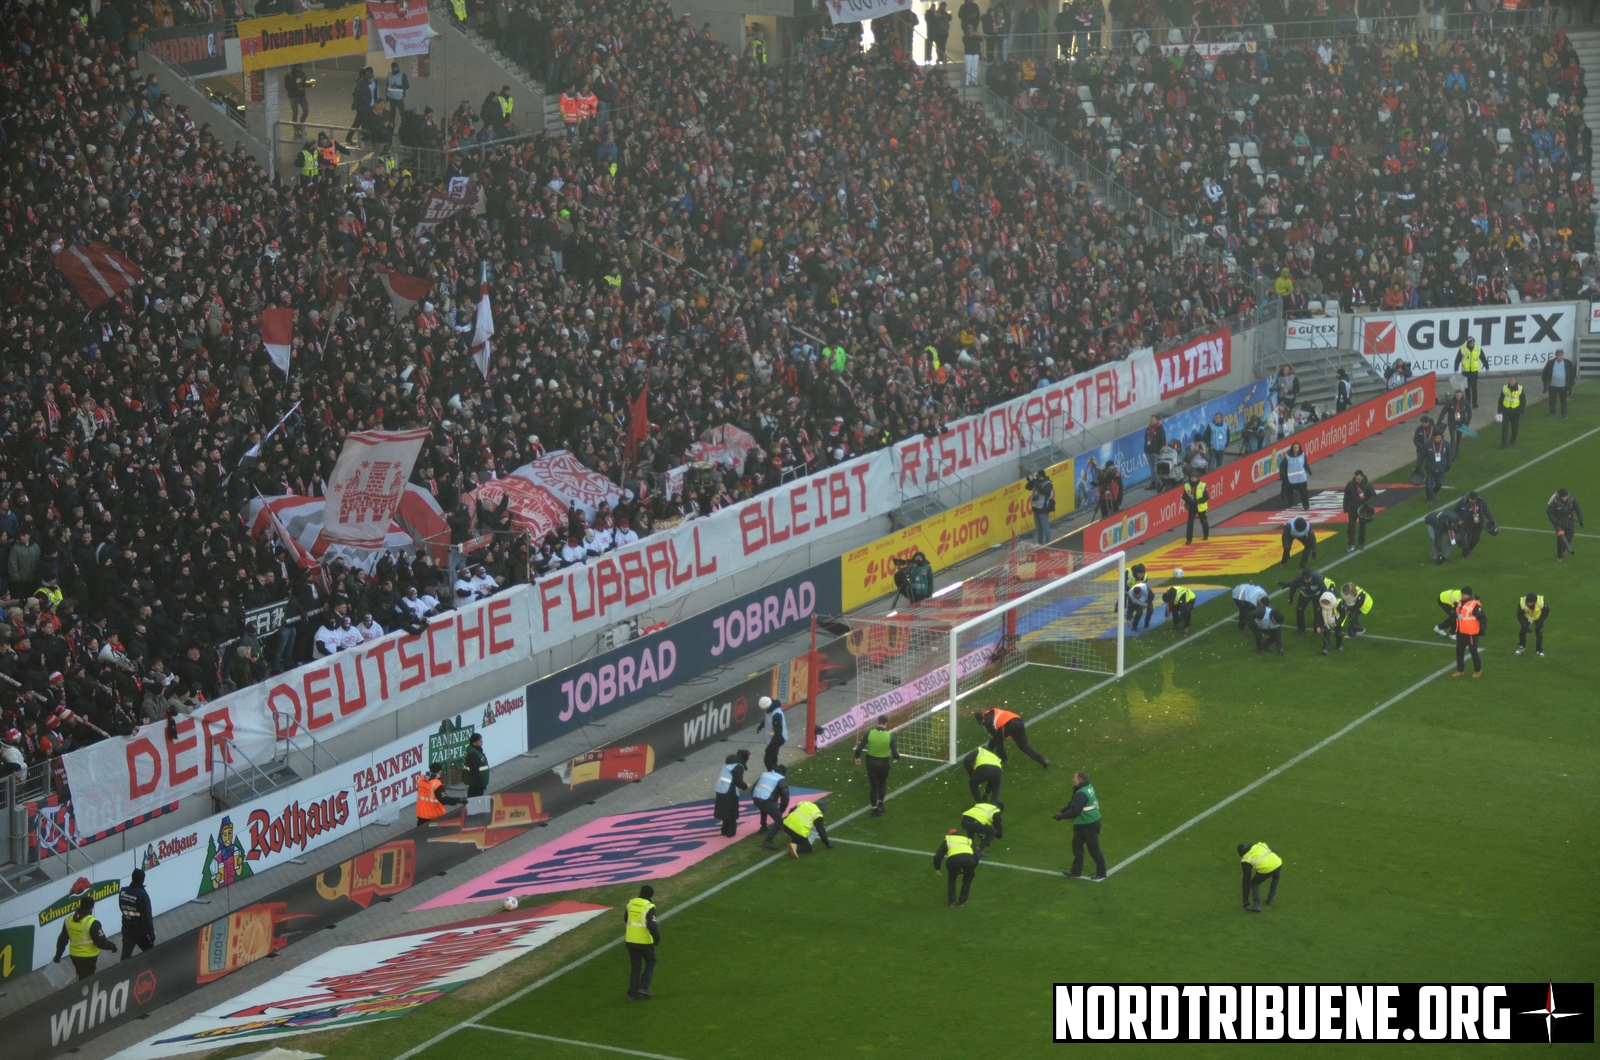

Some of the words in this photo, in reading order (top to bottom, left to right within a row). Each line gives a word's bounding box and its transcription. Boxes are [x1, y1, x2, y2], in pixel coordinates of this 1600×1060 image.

[261, 27, 303, 52] Dreisam
[305, 22, 332, 48] Magic
[335, 18, 347, 39] 95
[1298, 325, 1336, 335] GUTEX
[1407, 312, 1565, 350] GUTEX
[1524, 352, 1554, 364] FASE
[1320, 424, 1348, 449] Anfang
[1349, 413, 1361, 435] an!
[1008, 483, 1022, 495] LOTTO
[959, 503, 973, 515] LOTTO
[907, 525, 922, 537] LOTTO
[953, 515, 990, 549] LOTTO
[853, 547, 868, 560] LOTTO
[126, 707, 234, 800] DER
[267, 598, 515, 742] DEUTSCHE
[739, 462, 870, 556] BLEIBT
[899, 360, 1138, 489] RISIKOKAPITAL!
[710, 581, 816, 656] JOBRAD
[558, 640, 677, 722] JOBRAD
[912, 670, 951, 697] JOBRAD
[494, 695, 524, 718] Rothaus
[860, 692, 904, 719] JOBRAD
[431, 727, 473, 749] TANNEN
[683, 700, 732, 748] wiha
[819, 714, 857, 744] JOBRAD
[353, 743, 423, 793] TANNEN
[431, 744, 470, 764] ZÄPFL
[617, 769, 635, 780] wiha
[357, 770, 423, 819] ZÄPFLE
[246, 790, 350, 861] Rothaus
[157, 832, 198, 860] Rothaus
[51, 979, 131, 1047] wiha
